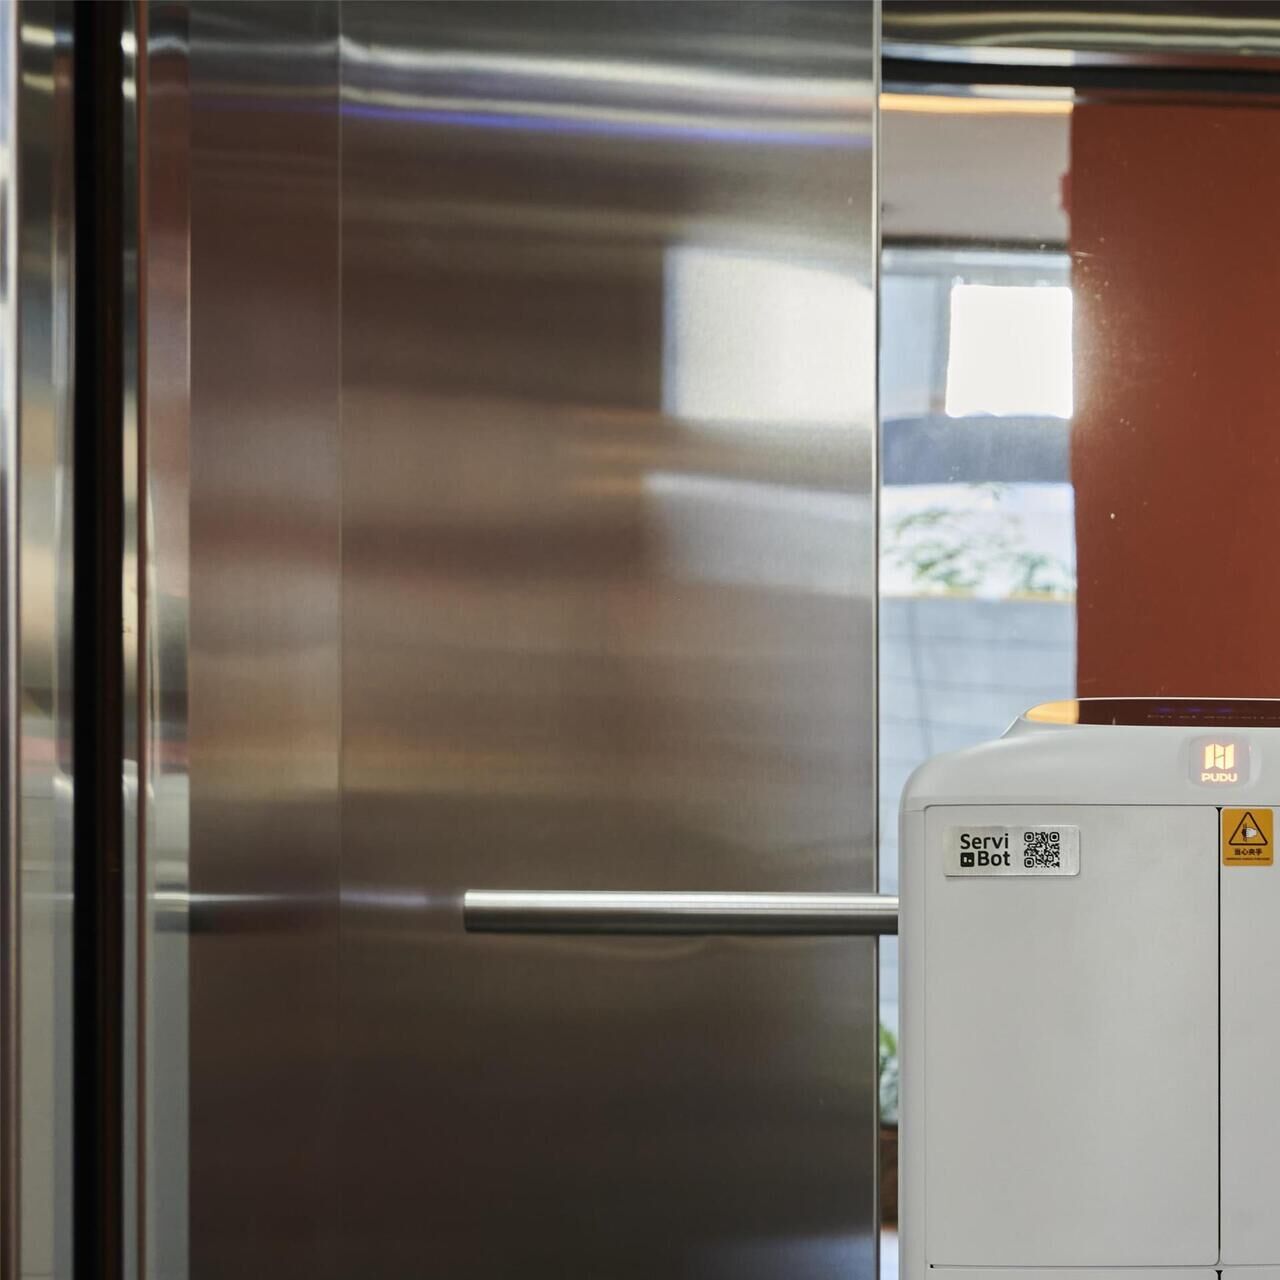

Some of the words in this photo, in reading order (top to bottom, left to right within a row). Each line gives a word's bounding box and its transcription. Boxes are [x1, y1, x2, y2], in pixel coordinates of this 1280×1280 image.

[1201, 772, 1238, 783] PUDU
[960, 833, 1009, 850] Servi
[977, 851, 1011, 866] Bot
